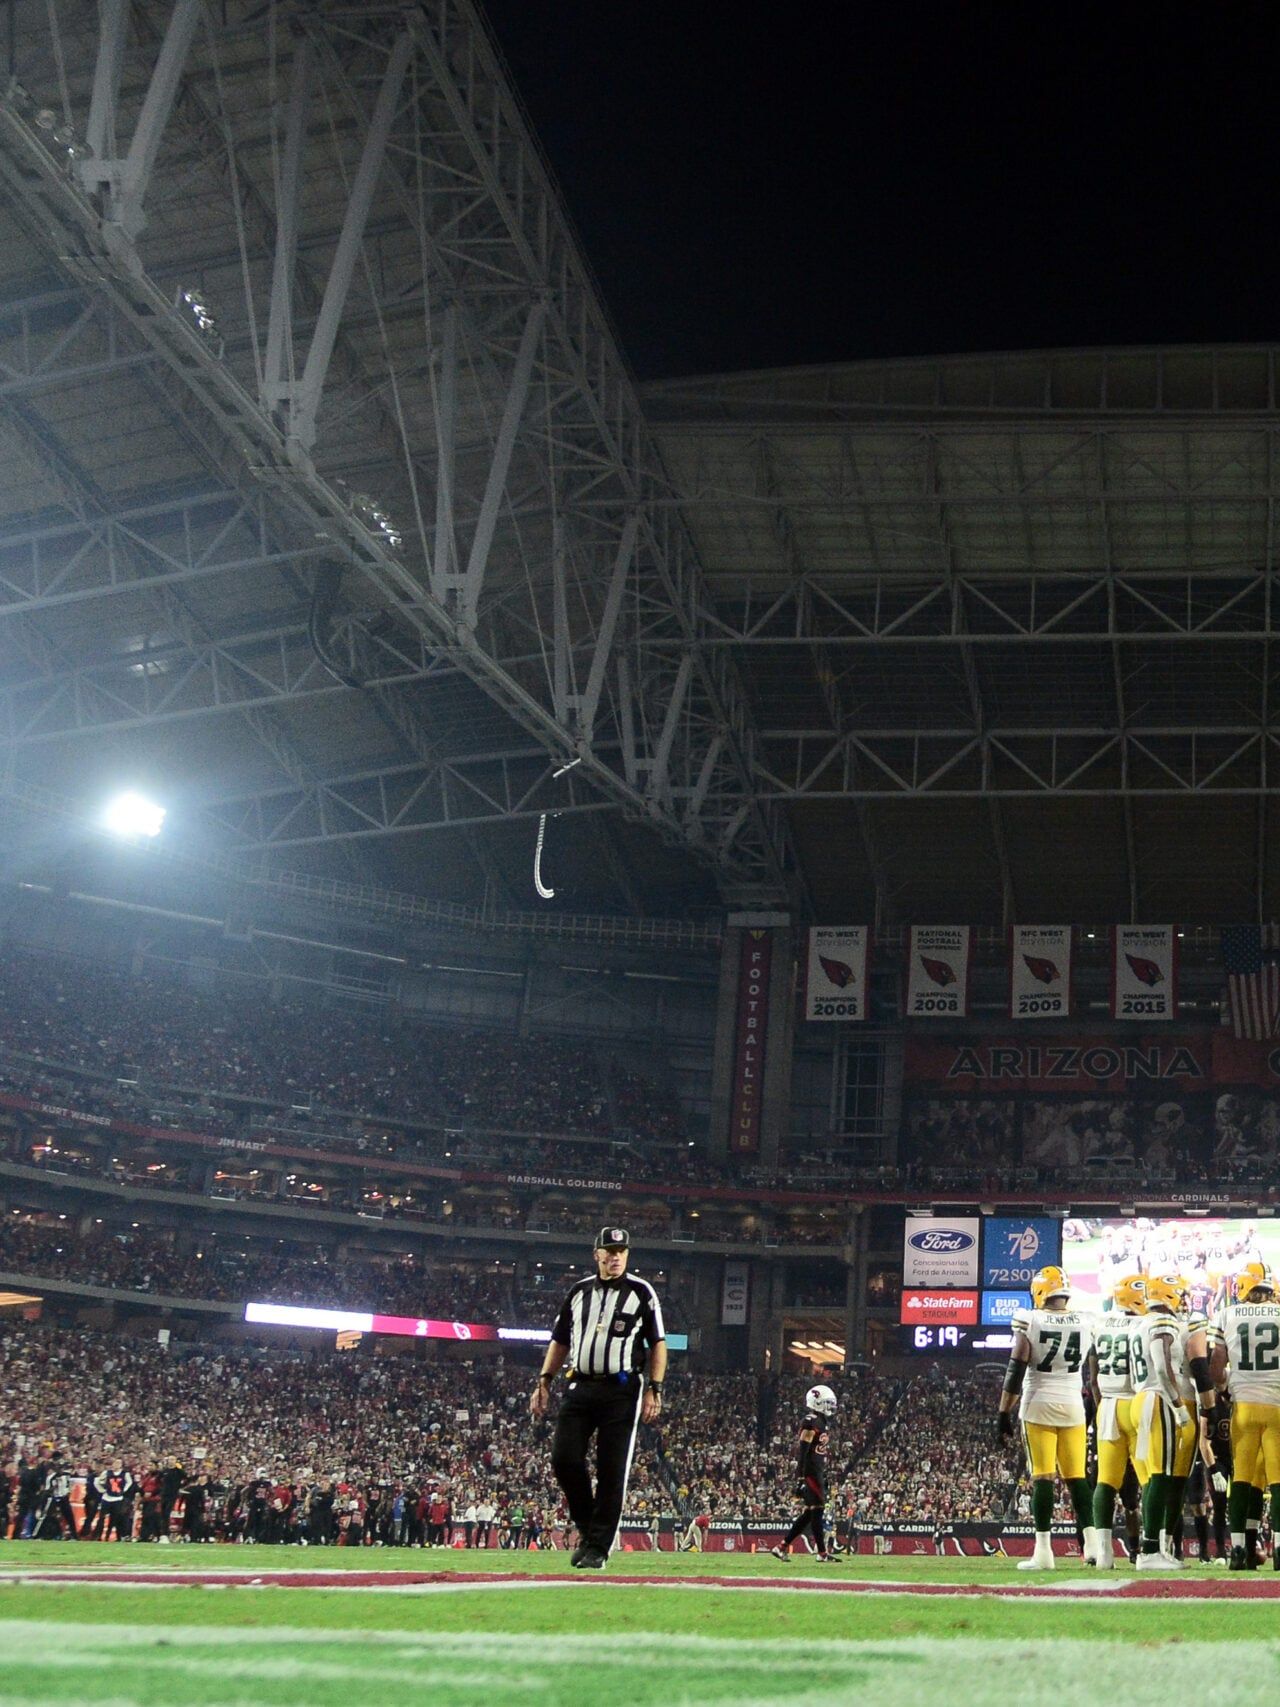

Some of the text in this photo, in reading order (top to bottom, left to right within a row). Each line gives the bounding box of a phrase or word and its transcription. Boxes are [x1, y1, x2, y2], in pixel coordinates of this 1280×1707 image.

[816, 938, 860, 946] DIVISION
[1020, 938, 1063, 946] DIVISION
[1122, 938, 1166, 946] DIVISION
[814, 1003, 858, 1015] 2008
[914, 999, 958, 1011] 2008
[1019, 1000, 1062, 1013] 2009
[1122, 1001, 1166, 1013] 2015
[739, 952, 761, 1146] FOOTBALL CLUB
[945, 1047, 1204, 1079] ARIZONA
[236, 1140, 267, 1151] HART
[508, 1175, 622, 1190] MARSHALL GOLDBERG
[1171, 1194, 1230, 1202] CARDINALS
[920, 1232, 963, 1250] Ford
[995, 1299, 1020, 1308] BUD
[922, 1311, 957, 1319] STADIUM
[1234, 1306, 1280, 1318] RODGERS
[1044, 1314, 1081, 1325] JENKINS
[914, 1326, 959, 1348] 6:19
[1036, 1330, 1083, 1374] 74
[1236, 1321, 1280, 1371] 12
[747, 1522, 793, 1532] CARDINA
